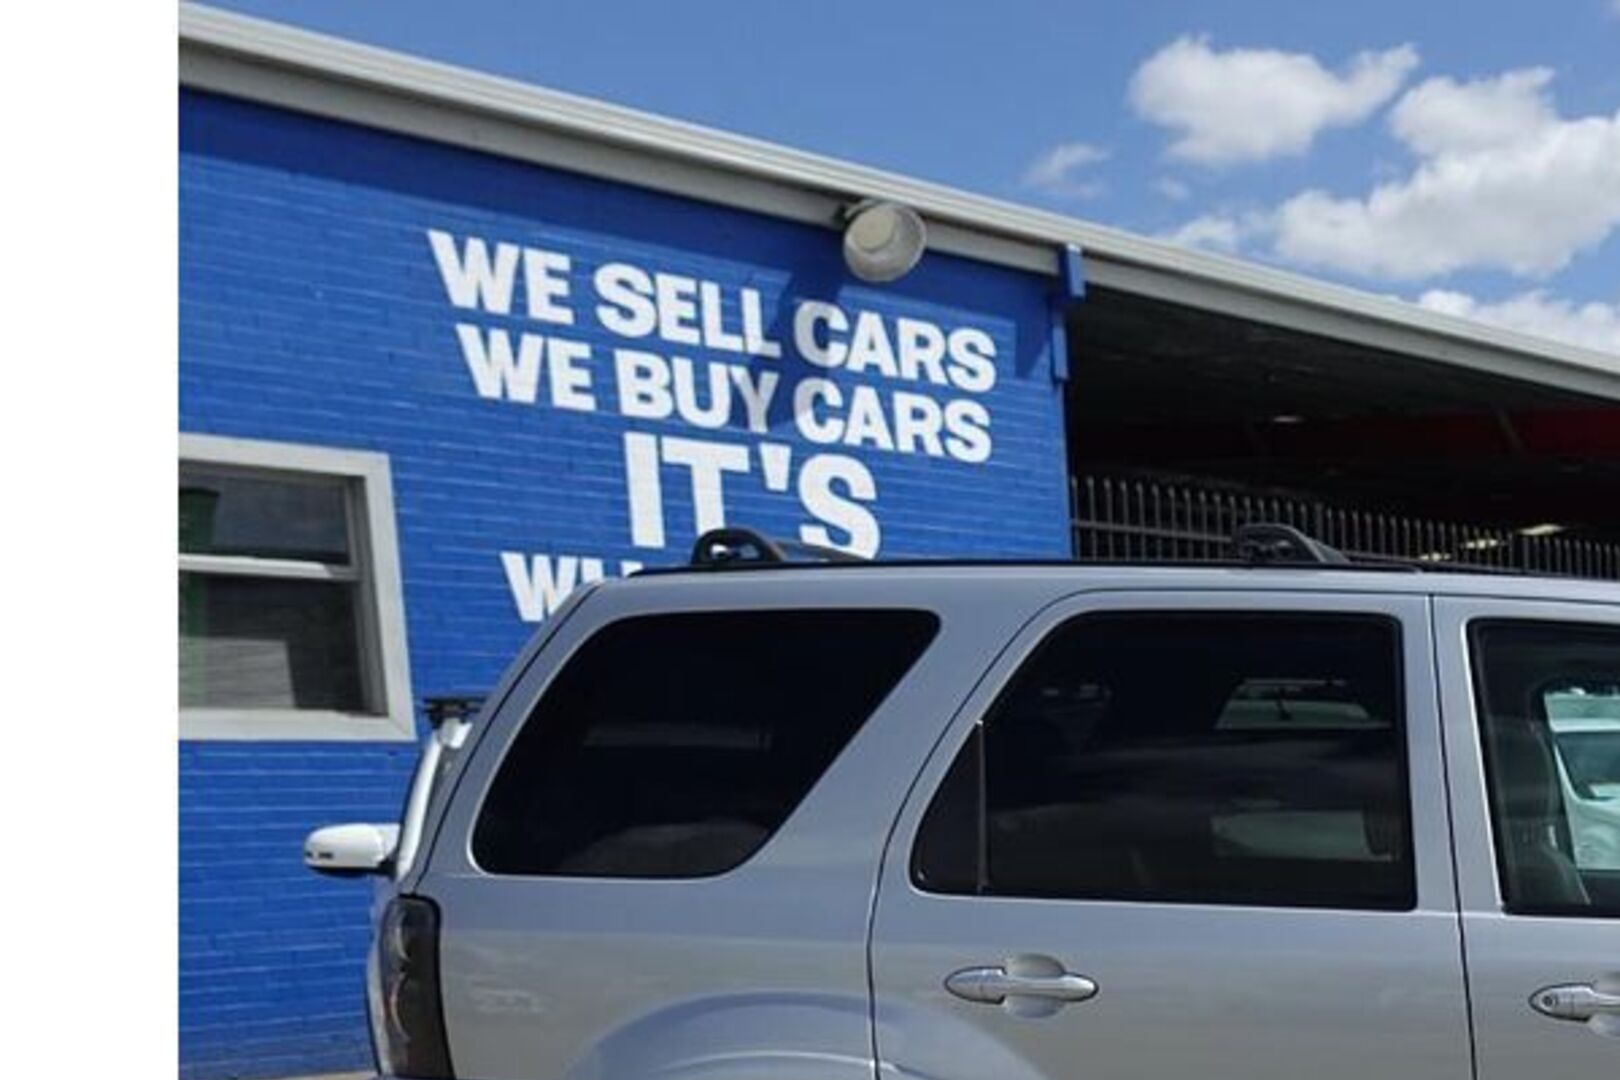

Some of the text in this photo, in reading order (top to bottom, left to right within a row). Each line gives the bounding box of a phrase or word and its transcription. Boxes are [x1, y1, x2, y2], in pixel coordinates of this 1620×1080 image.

[429, 229, 996, 393] WE SELL CARS
[457, 324, 992, 463] WE BUY CARS
[623, 431, 881, 559] IT'S
